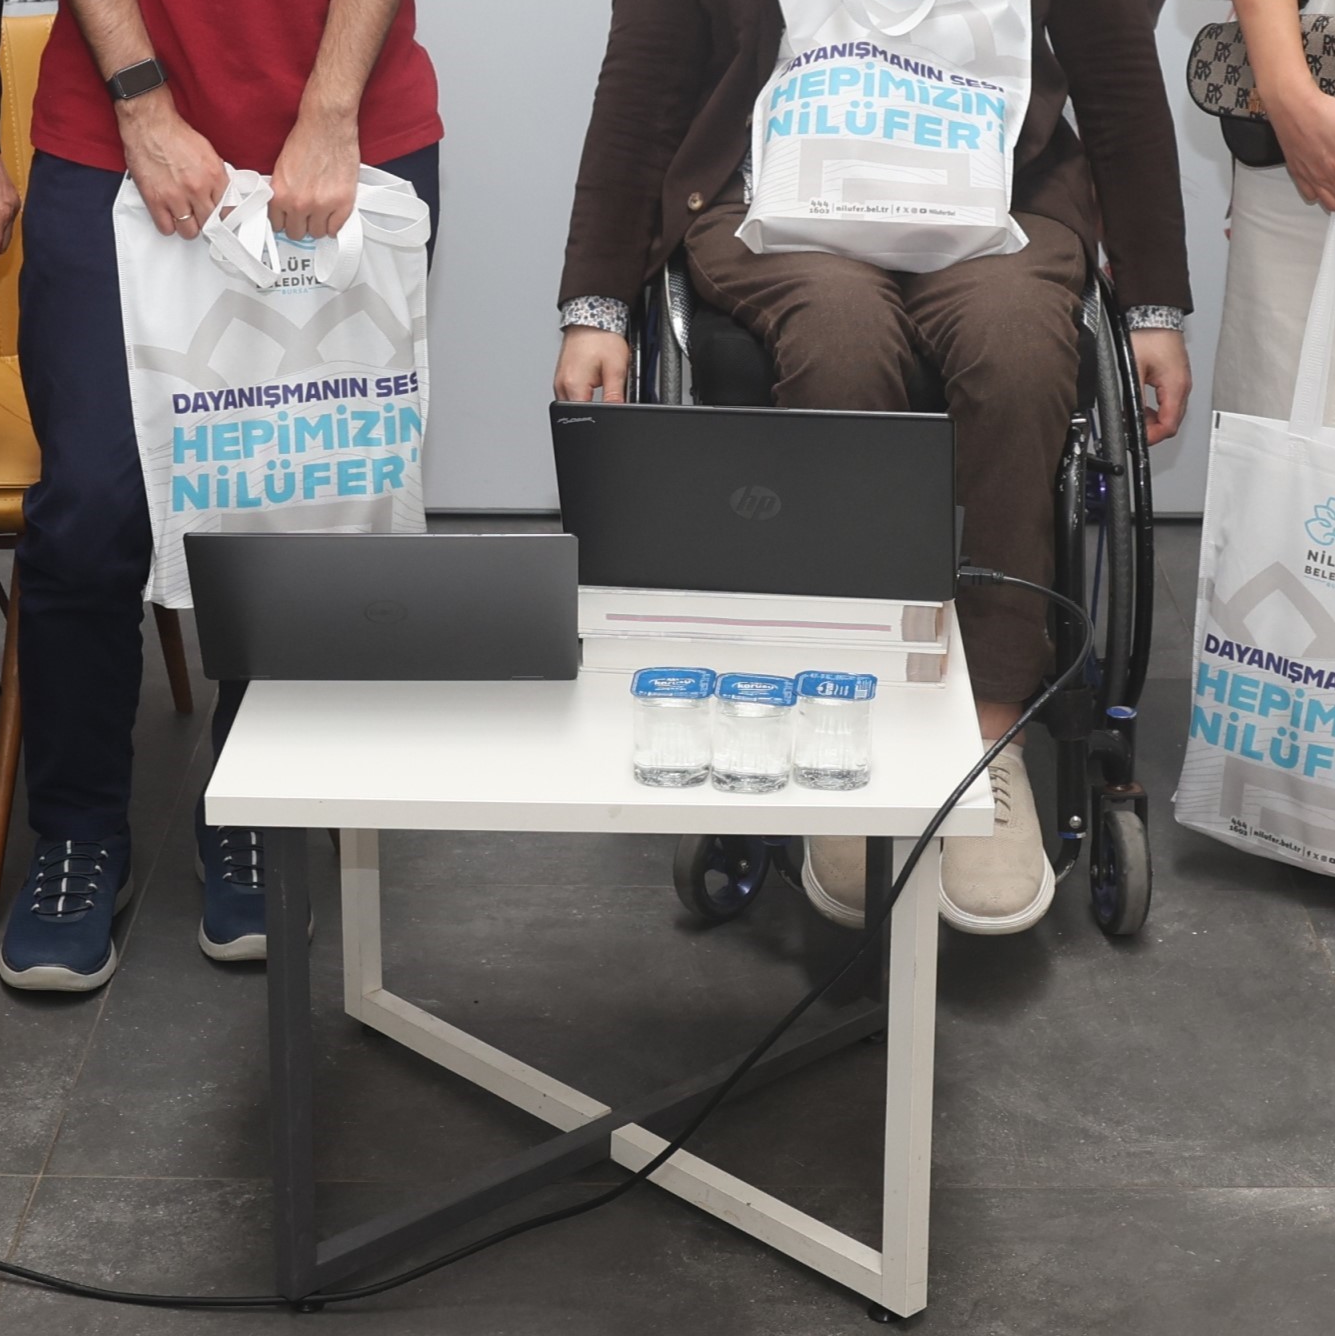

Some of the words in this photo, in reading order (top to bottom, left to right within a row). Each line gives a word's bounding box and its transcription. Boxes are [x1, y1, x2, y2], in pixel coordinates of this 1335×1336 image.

[770, 61, 1005, 120] HEPİMİZİN
[836, 205, 889, 213] nilufer.bel.tr
[282, 287, 309, 295] BURSA
[172, 377, 368, 414] DAYANIŞMANIN
[375, 371, 418, 398] SES
[172, 402, 422, 464] HEPİMİZİN
[736, 486, 776, 520] hp
[1254, 830, 1301, 853] nilufer.bel.tr
